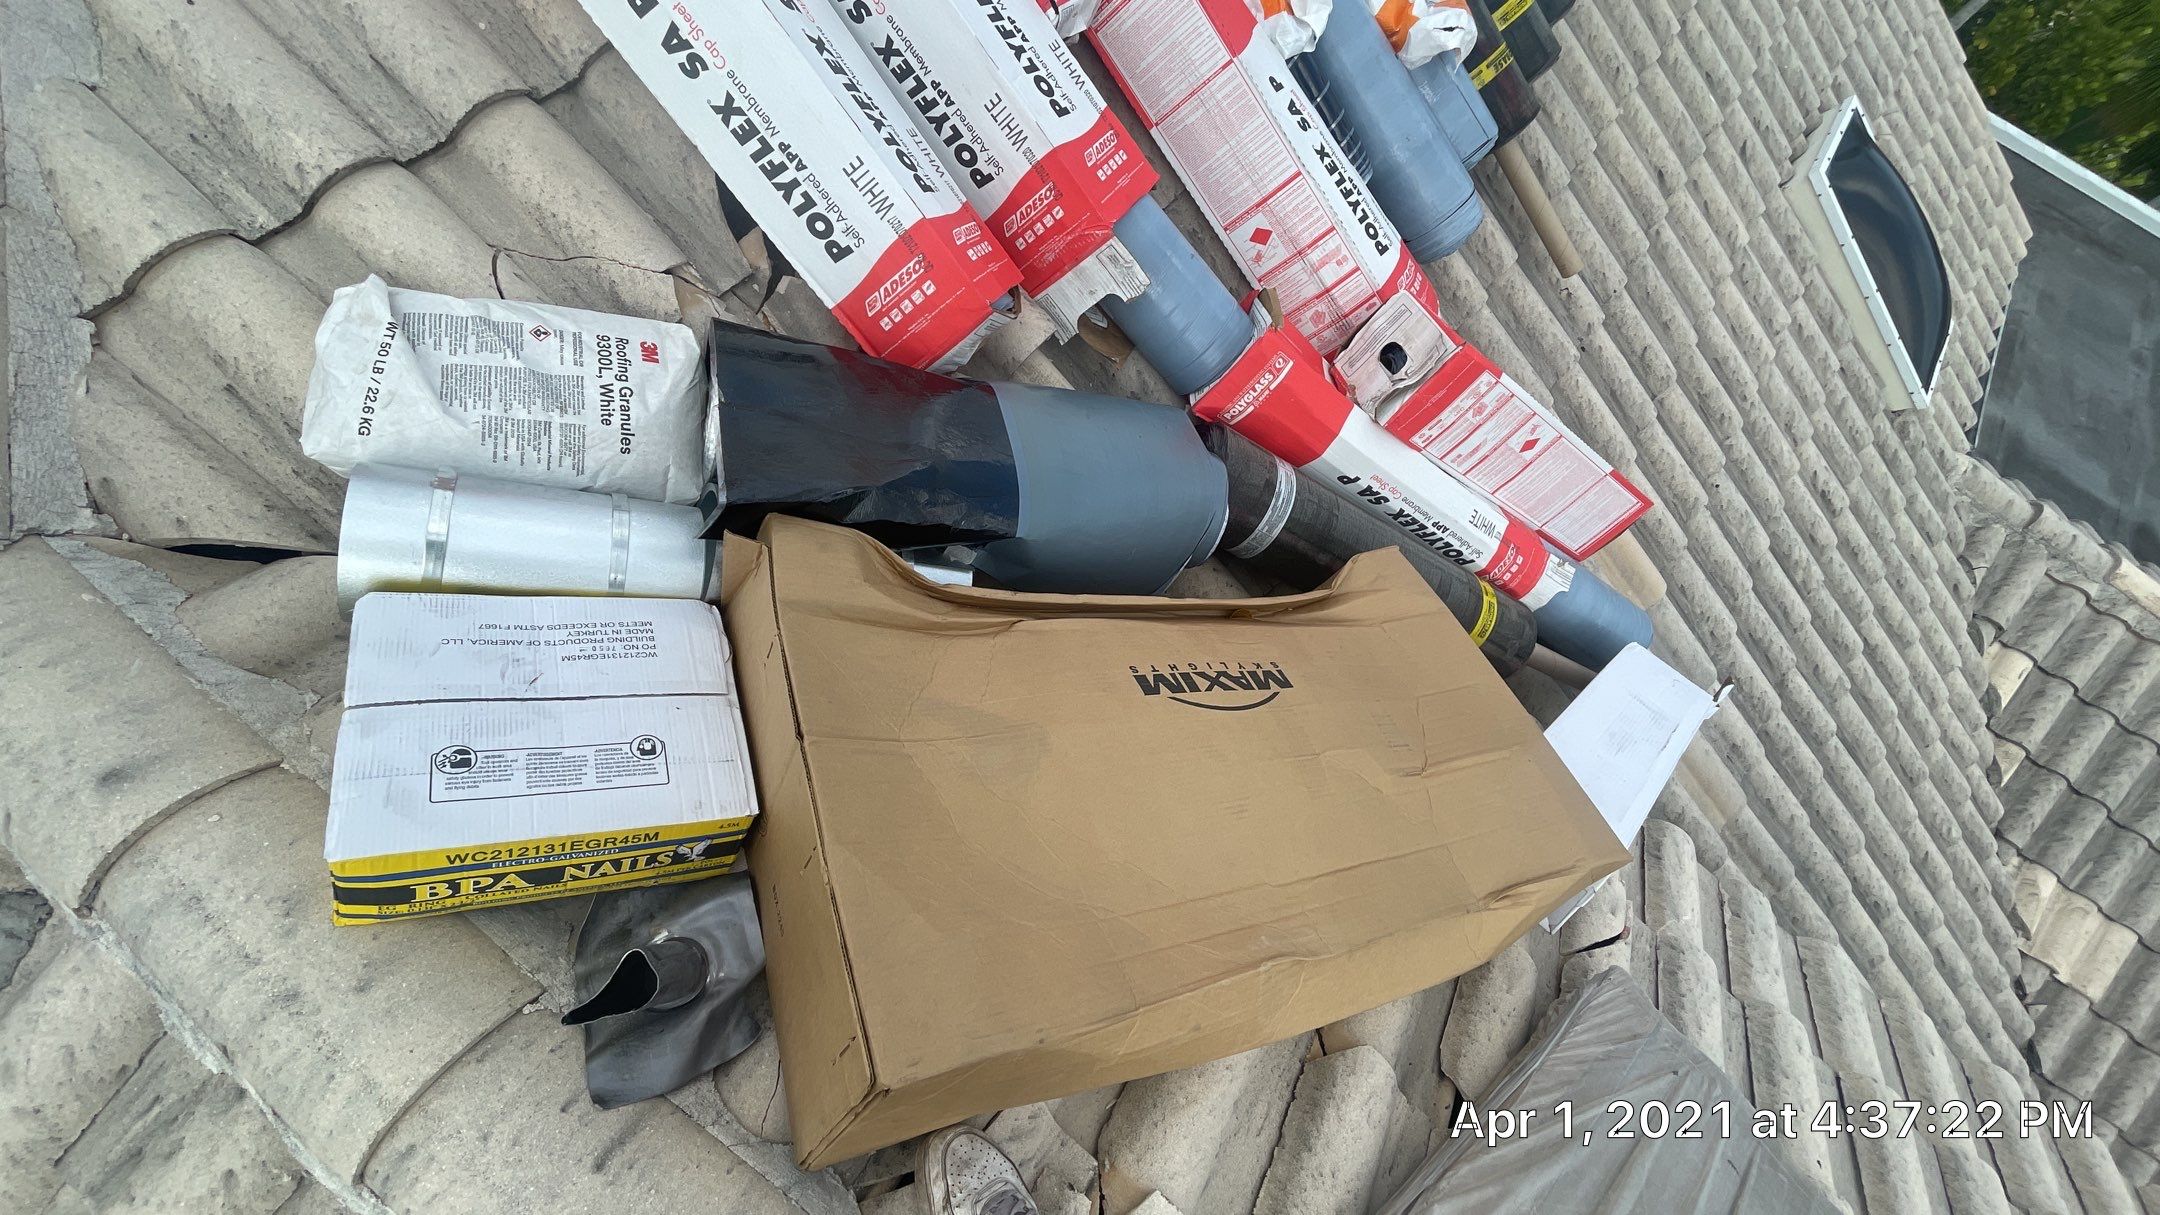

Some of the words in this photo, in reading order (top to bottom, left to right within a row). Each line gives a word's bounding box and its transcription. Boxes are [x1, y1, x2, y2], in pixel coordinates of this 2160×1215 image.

[669, 0, 706, 42] Sheet
[1005, 14, 1030, 44] APP
[661, 21, 709, 79] SA
[699, 36, 728, 70] Cap
[814, 24, 863, 87] Membrane
[882, 13, 932, 77] Membrane
[1027, 45, 1077, 112] Self-Adhered
[1049, 39, 1085, 90] WHITE
[928, 76, 955, 108] APP
[1269, 76, 1284, 92] P
[1289, 87, 1307, 111] Sheet
[722, 68, 781, 138] Membrane
[805, 33, 935, 193] POLYFLEX
[862, 89, 888, 122] APP
[871, 34, 995, 189] POLYFLEX
[1288, 98, 1311, 132] SA
[1304, 110, 1320, 130] Cap
[984, 93, 1028, 151] WHITE
[776, 138, 808, 174] APP
[887, 123, 940, 193] Self-Adhered
[906, 128, 944, 178] WHITE
[950, 107, 1004, 176] Self-Adhered
[1317, 129, 1348, 173] Membrane
[710, 90, 854, 263] POLYFLEX
[843, 156, 894, 220] WHITE
[1346, 175, 1363, 196] APP
[802, 172, 866, 249] Self-Adhered
[1313, 143, 1389, 256] POLYFLEX
[1360, 196, 1395, 246] Self-Adhered
[384, 322, 399, 340] WT
[378, 342, 391, 356] 50
[596, 335, 613, 378] 9300L,
[615, 338, 632, 382] Roofing
[640, 340, 658, 364] 3M
[369, 376, 381, 384] /
[373, 360, 386, 374] LB
[362, 387, 379, 414] 22.6
[600, 383, 615, 426] White
[1223, 370, 1274, 420] POLYGLASS
[358, 417, 372, 436] KG
[619, 387, 635, 454] Granules
[1337, 473, 1361, 486] P
[1358, 485, 1391, 506] SA
[1368, 472, 1389, 490] Sheet
[1386, 484, 1402, 500] Cap
[1399, 495, 1433, 523] Membrane
[1431, 518, 1449, 534] APP
[1469, 509, 1496, 538] WHITE
[1388, 505, 1475, 568] POLYFLEX
[1446, 529, 1483, 559] Self-Adhered
[543, 637, 603, 646] PRODUCTS
[546, 622, 596, 630] EXCEEDS
[561, 651, 657, 661] WC212131EGR45M
[1129, 662, 1279, 673] SKYLIGHTS
[1133, 669, 1294, 696] MAXIM
[445, 830, 661, 866] WC212131EGR45M
[491, 847, 619, 870] ELECTRO-GALVANIZED
[410, 872, 535, 902] BPA
[562, 850, 675, 882] NAILS
